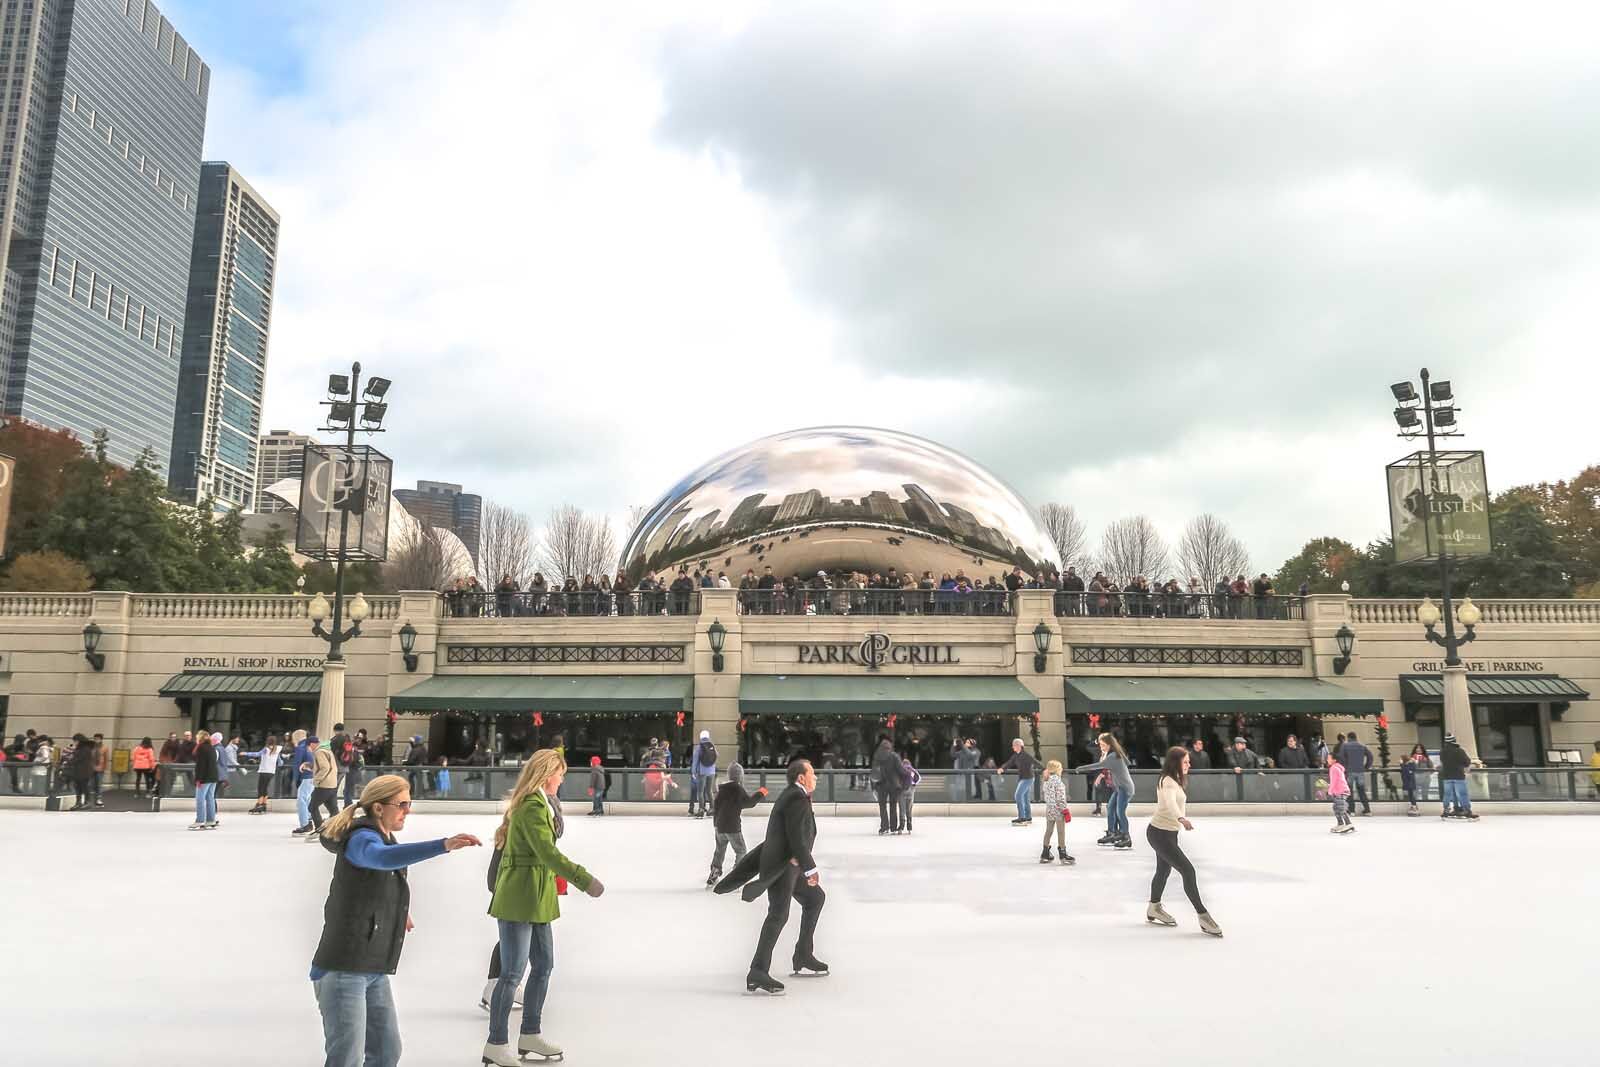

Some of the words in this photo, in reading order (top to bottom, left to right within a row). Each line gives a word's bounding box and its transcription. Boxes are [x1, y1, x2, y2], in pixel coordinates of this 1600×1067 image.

[1428, 479, 1481, 494] RELAX
[1429, 500, 1485, 513] LISTEN
[798, 645, 857, 663] PARK
[892, 645, 960, 663] GRILL
[183, 657, 229, 668] RENTAL
[237, 658, 268, 668] SHOP
[1463, 662, 1486, 673] AFE
[1493, 662, 1544, 673] PARKING
